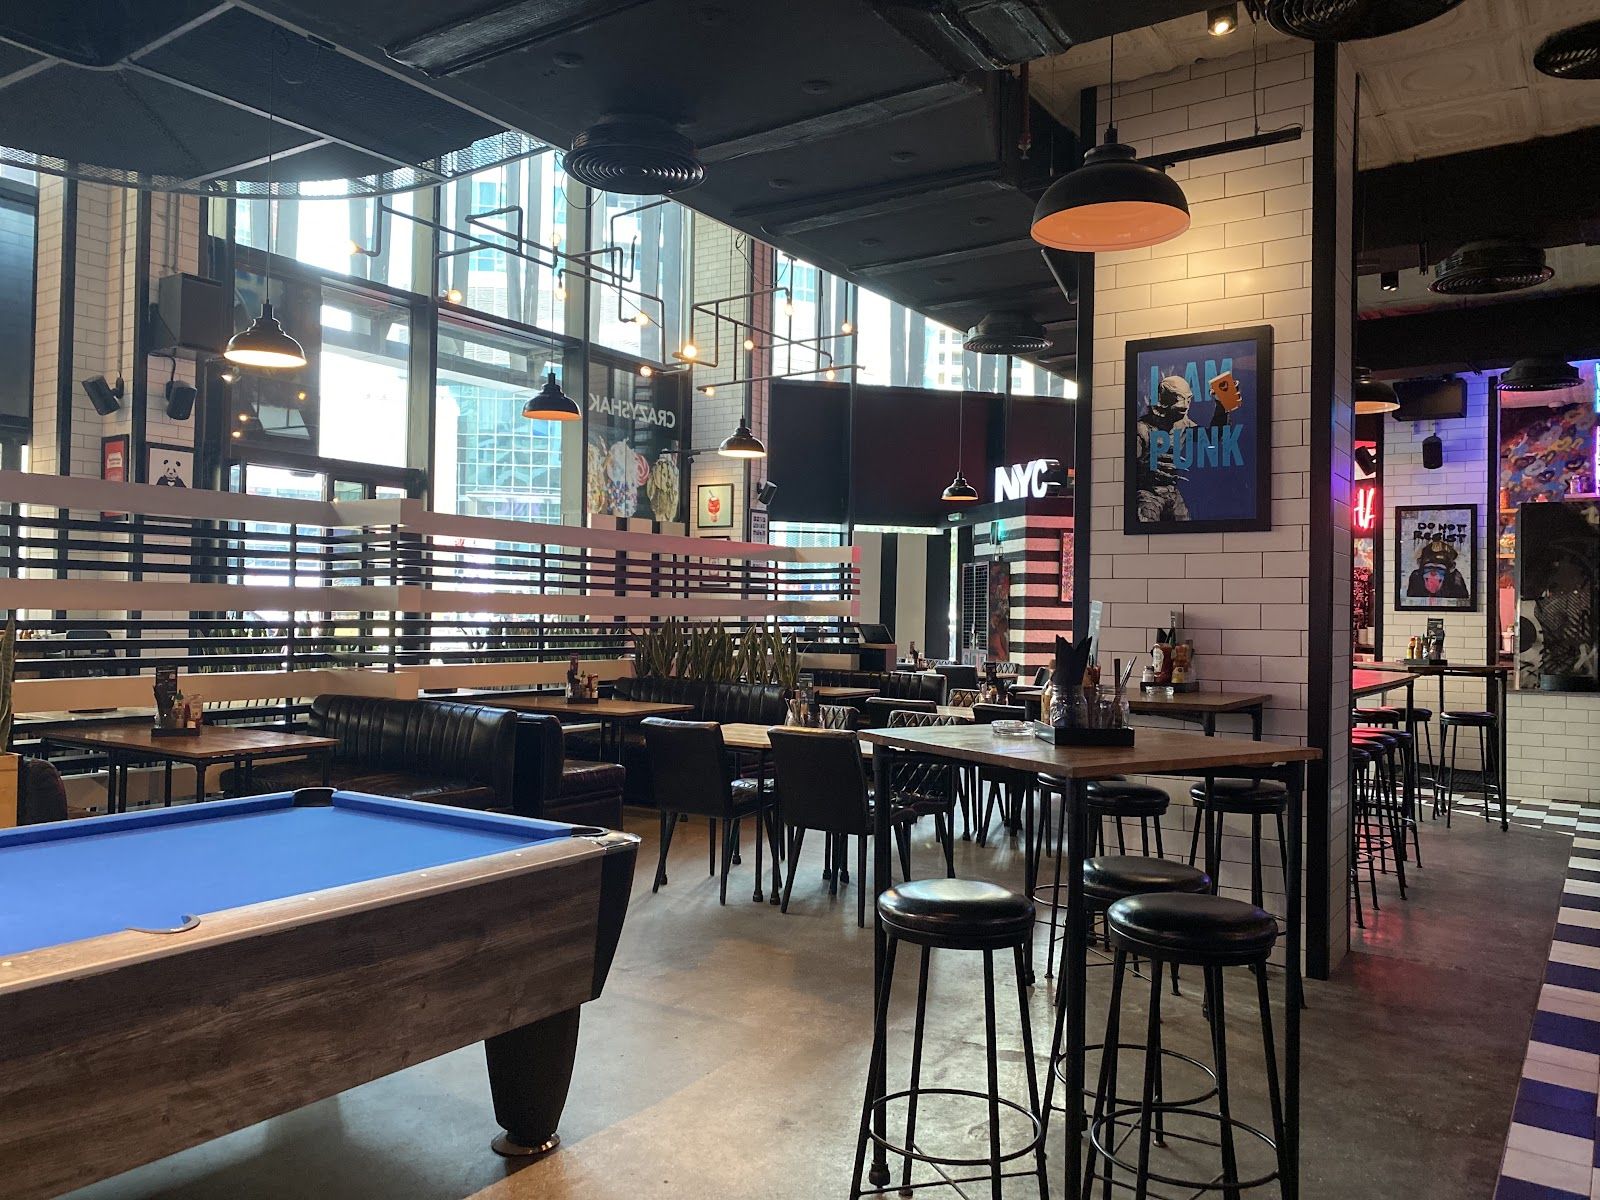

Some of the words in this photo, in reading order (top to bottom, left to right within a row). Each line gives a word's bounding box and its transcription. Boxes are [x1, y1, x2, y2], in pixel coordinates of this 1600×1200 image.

[1150, 365, 1160, 406] I
[1150, 424, 1245, 471] PUNK
[994, 459, 1049, 503] NYC
[1418, 522, 1436, 530] DO
